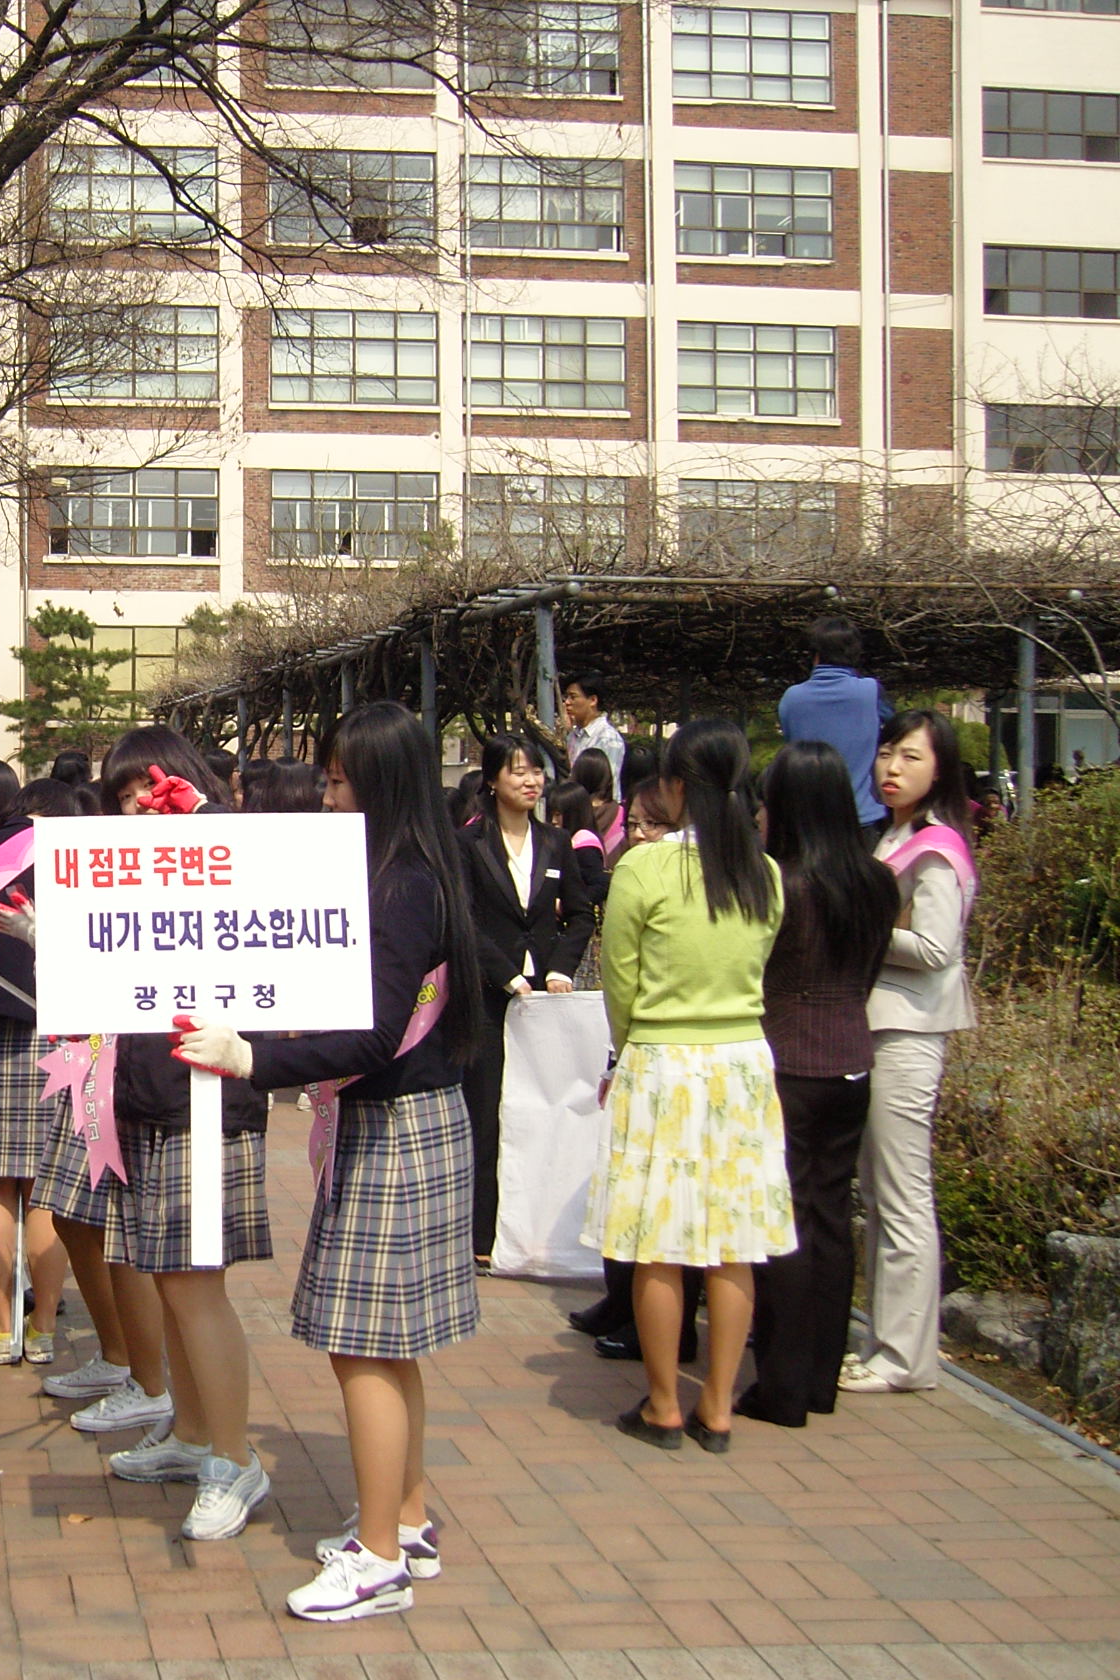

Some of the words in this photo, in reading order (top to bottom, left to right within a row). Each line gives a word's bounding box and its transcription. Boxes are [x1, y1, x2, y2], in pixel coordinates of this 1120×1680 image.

[53, 848, 79, 888] 내
[88, 847, 142, 888] 점포
[153, 845, 233, 886] 주변은
[87, 911, 141, 952] 내가
[151, 910, 203, 951] 먼저
[213, 907, 357, 951] 청소합시다.
